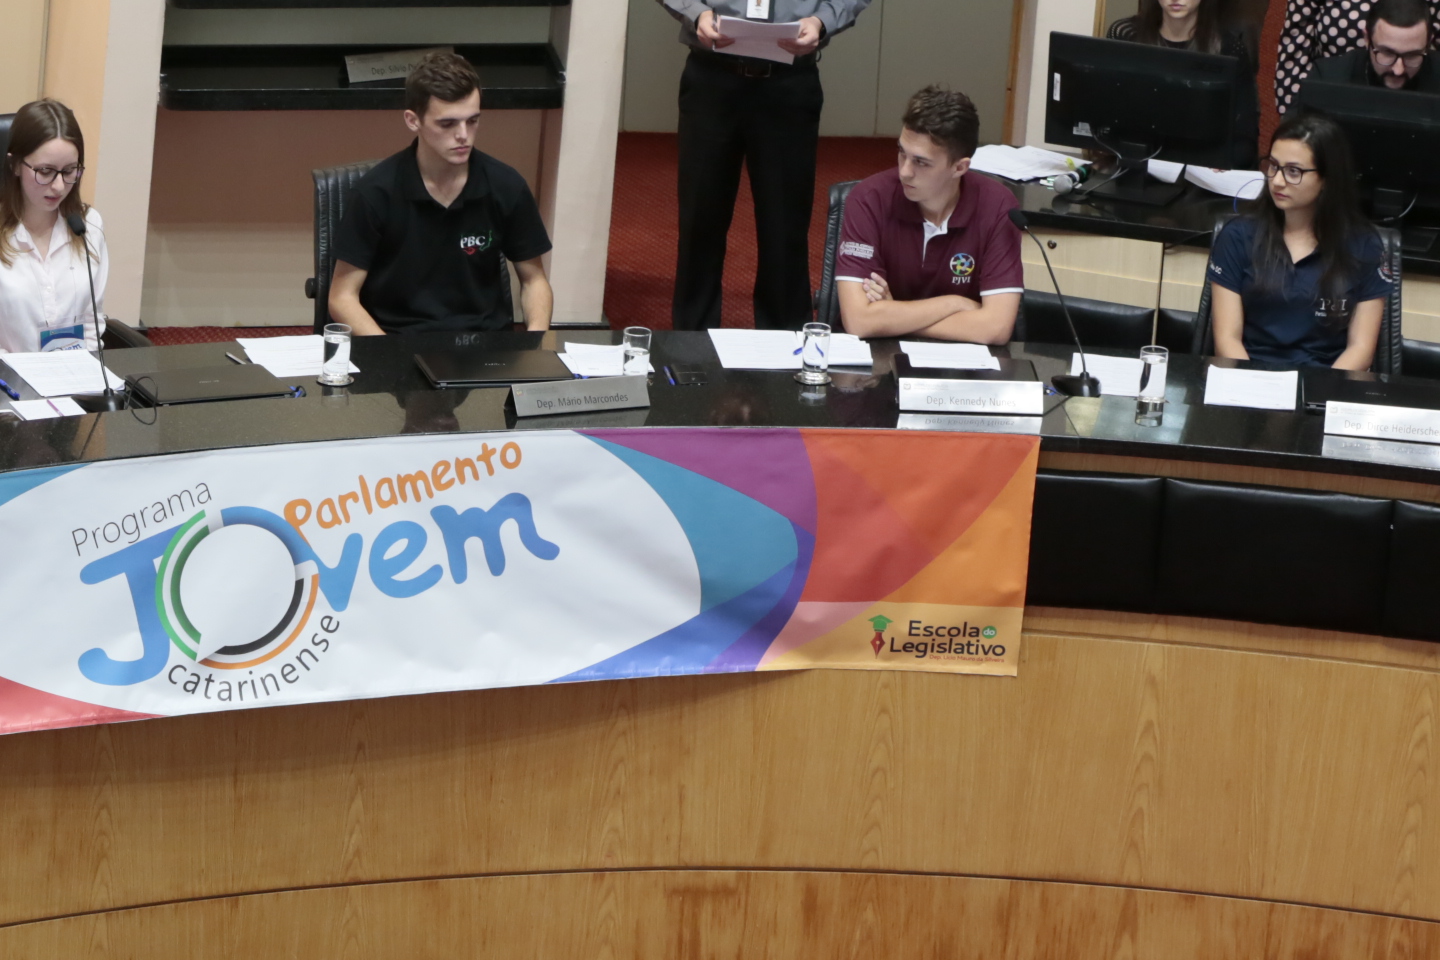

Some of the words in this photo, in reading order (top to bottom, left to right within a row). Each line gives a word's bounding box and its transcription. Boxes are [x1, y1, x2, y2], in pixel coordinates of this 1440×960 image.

[460, 235, 486, 249] PBC
[536, 399, 556, 410] Dep.
[557, 396, 582, 407] Mário
[583, 392, 629, 405] Marcondes
[926, 395, 946, 407] Dep.
[949, 396, 987, 408] Kennedy
[989, 398, 1016, 407] Nunes
[1344, 419, 1363, 431] Dep.
[1367, 421, 1389, 432] Dirce
[1391, 424, 1440, 437] Heidersche
[283, 441, 523, 547] Parlamento
[71, 481, 213, 557] Programa
[907, 619, 981, 638] Escola
[983, 628, 996, 637] do
[889, 636, 1006, 659] Legislativo
